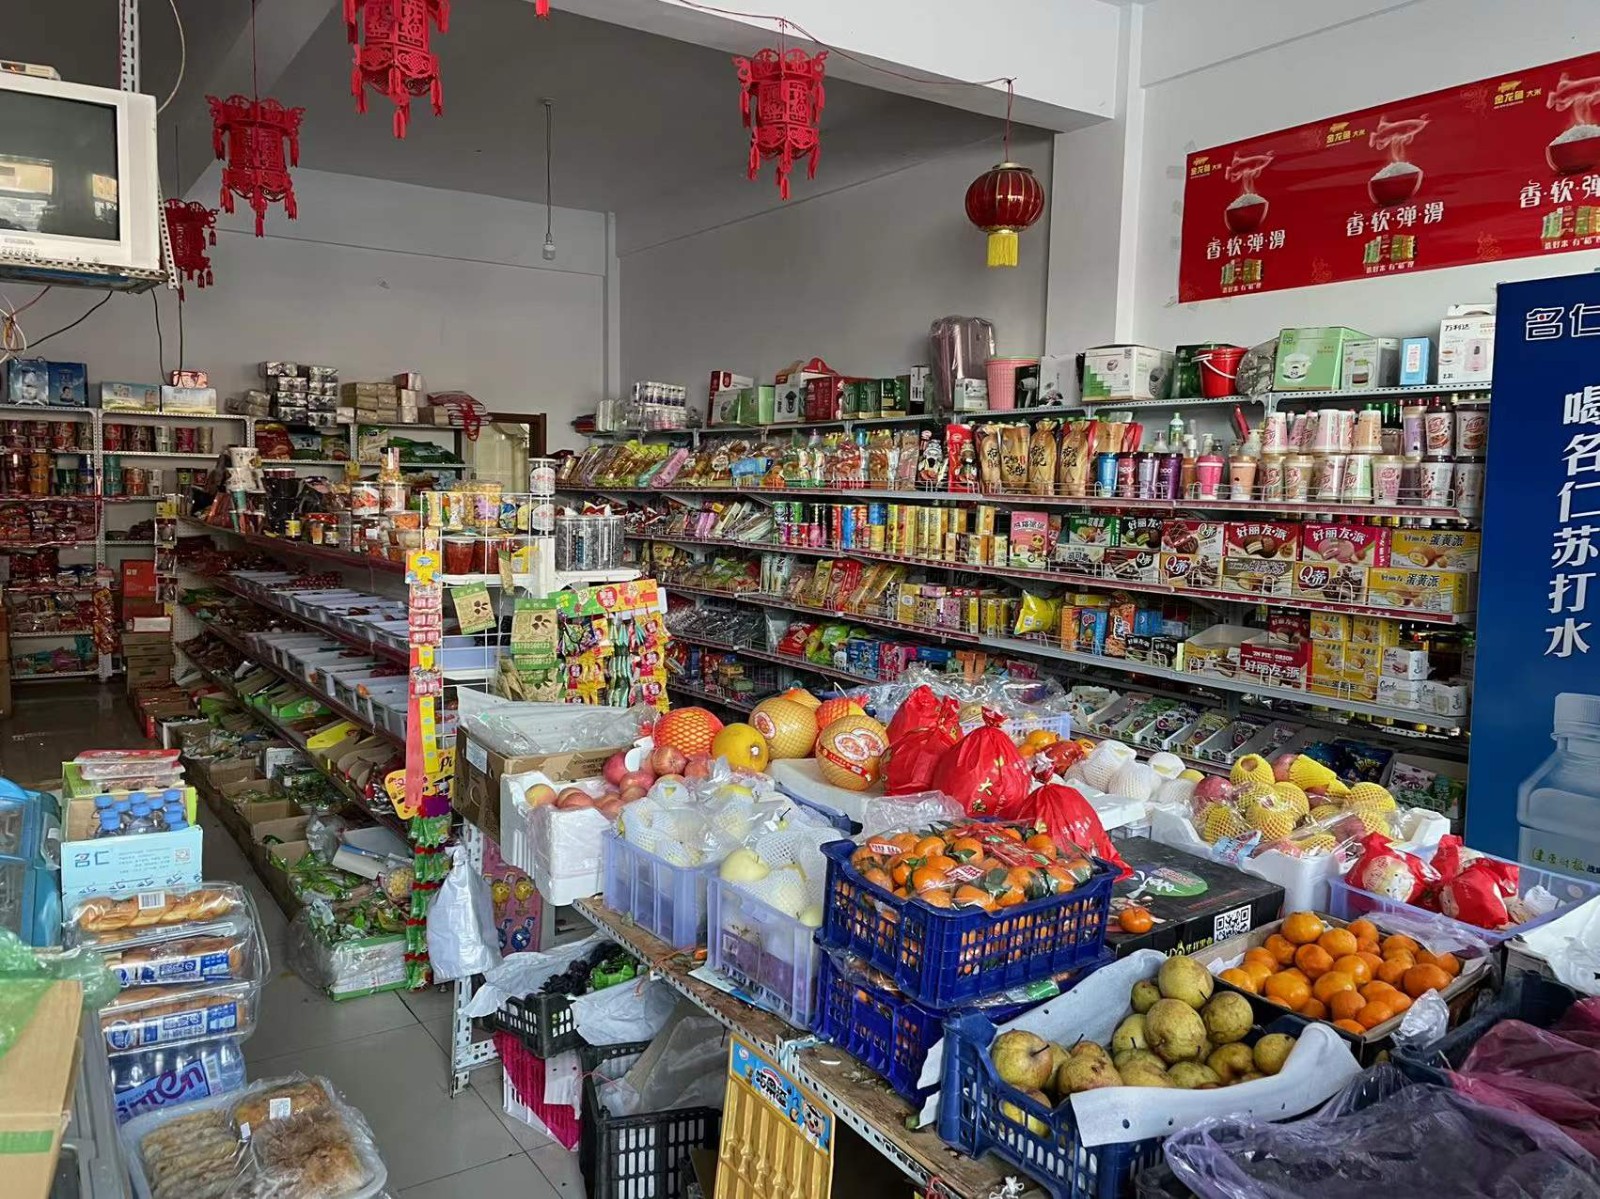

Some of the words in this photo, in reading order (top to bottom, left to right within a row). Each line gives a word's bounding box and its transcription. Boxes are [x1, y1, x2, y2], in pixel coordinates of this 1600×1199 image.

[1525, 303, 1600, 341] 名仁
[1236, 524, 1288, 542] 好丽友·派
[1543, 384, 1600, 658] 喝名仁苏打水
[1312, 526, 1366, 545] 好丽友·派
